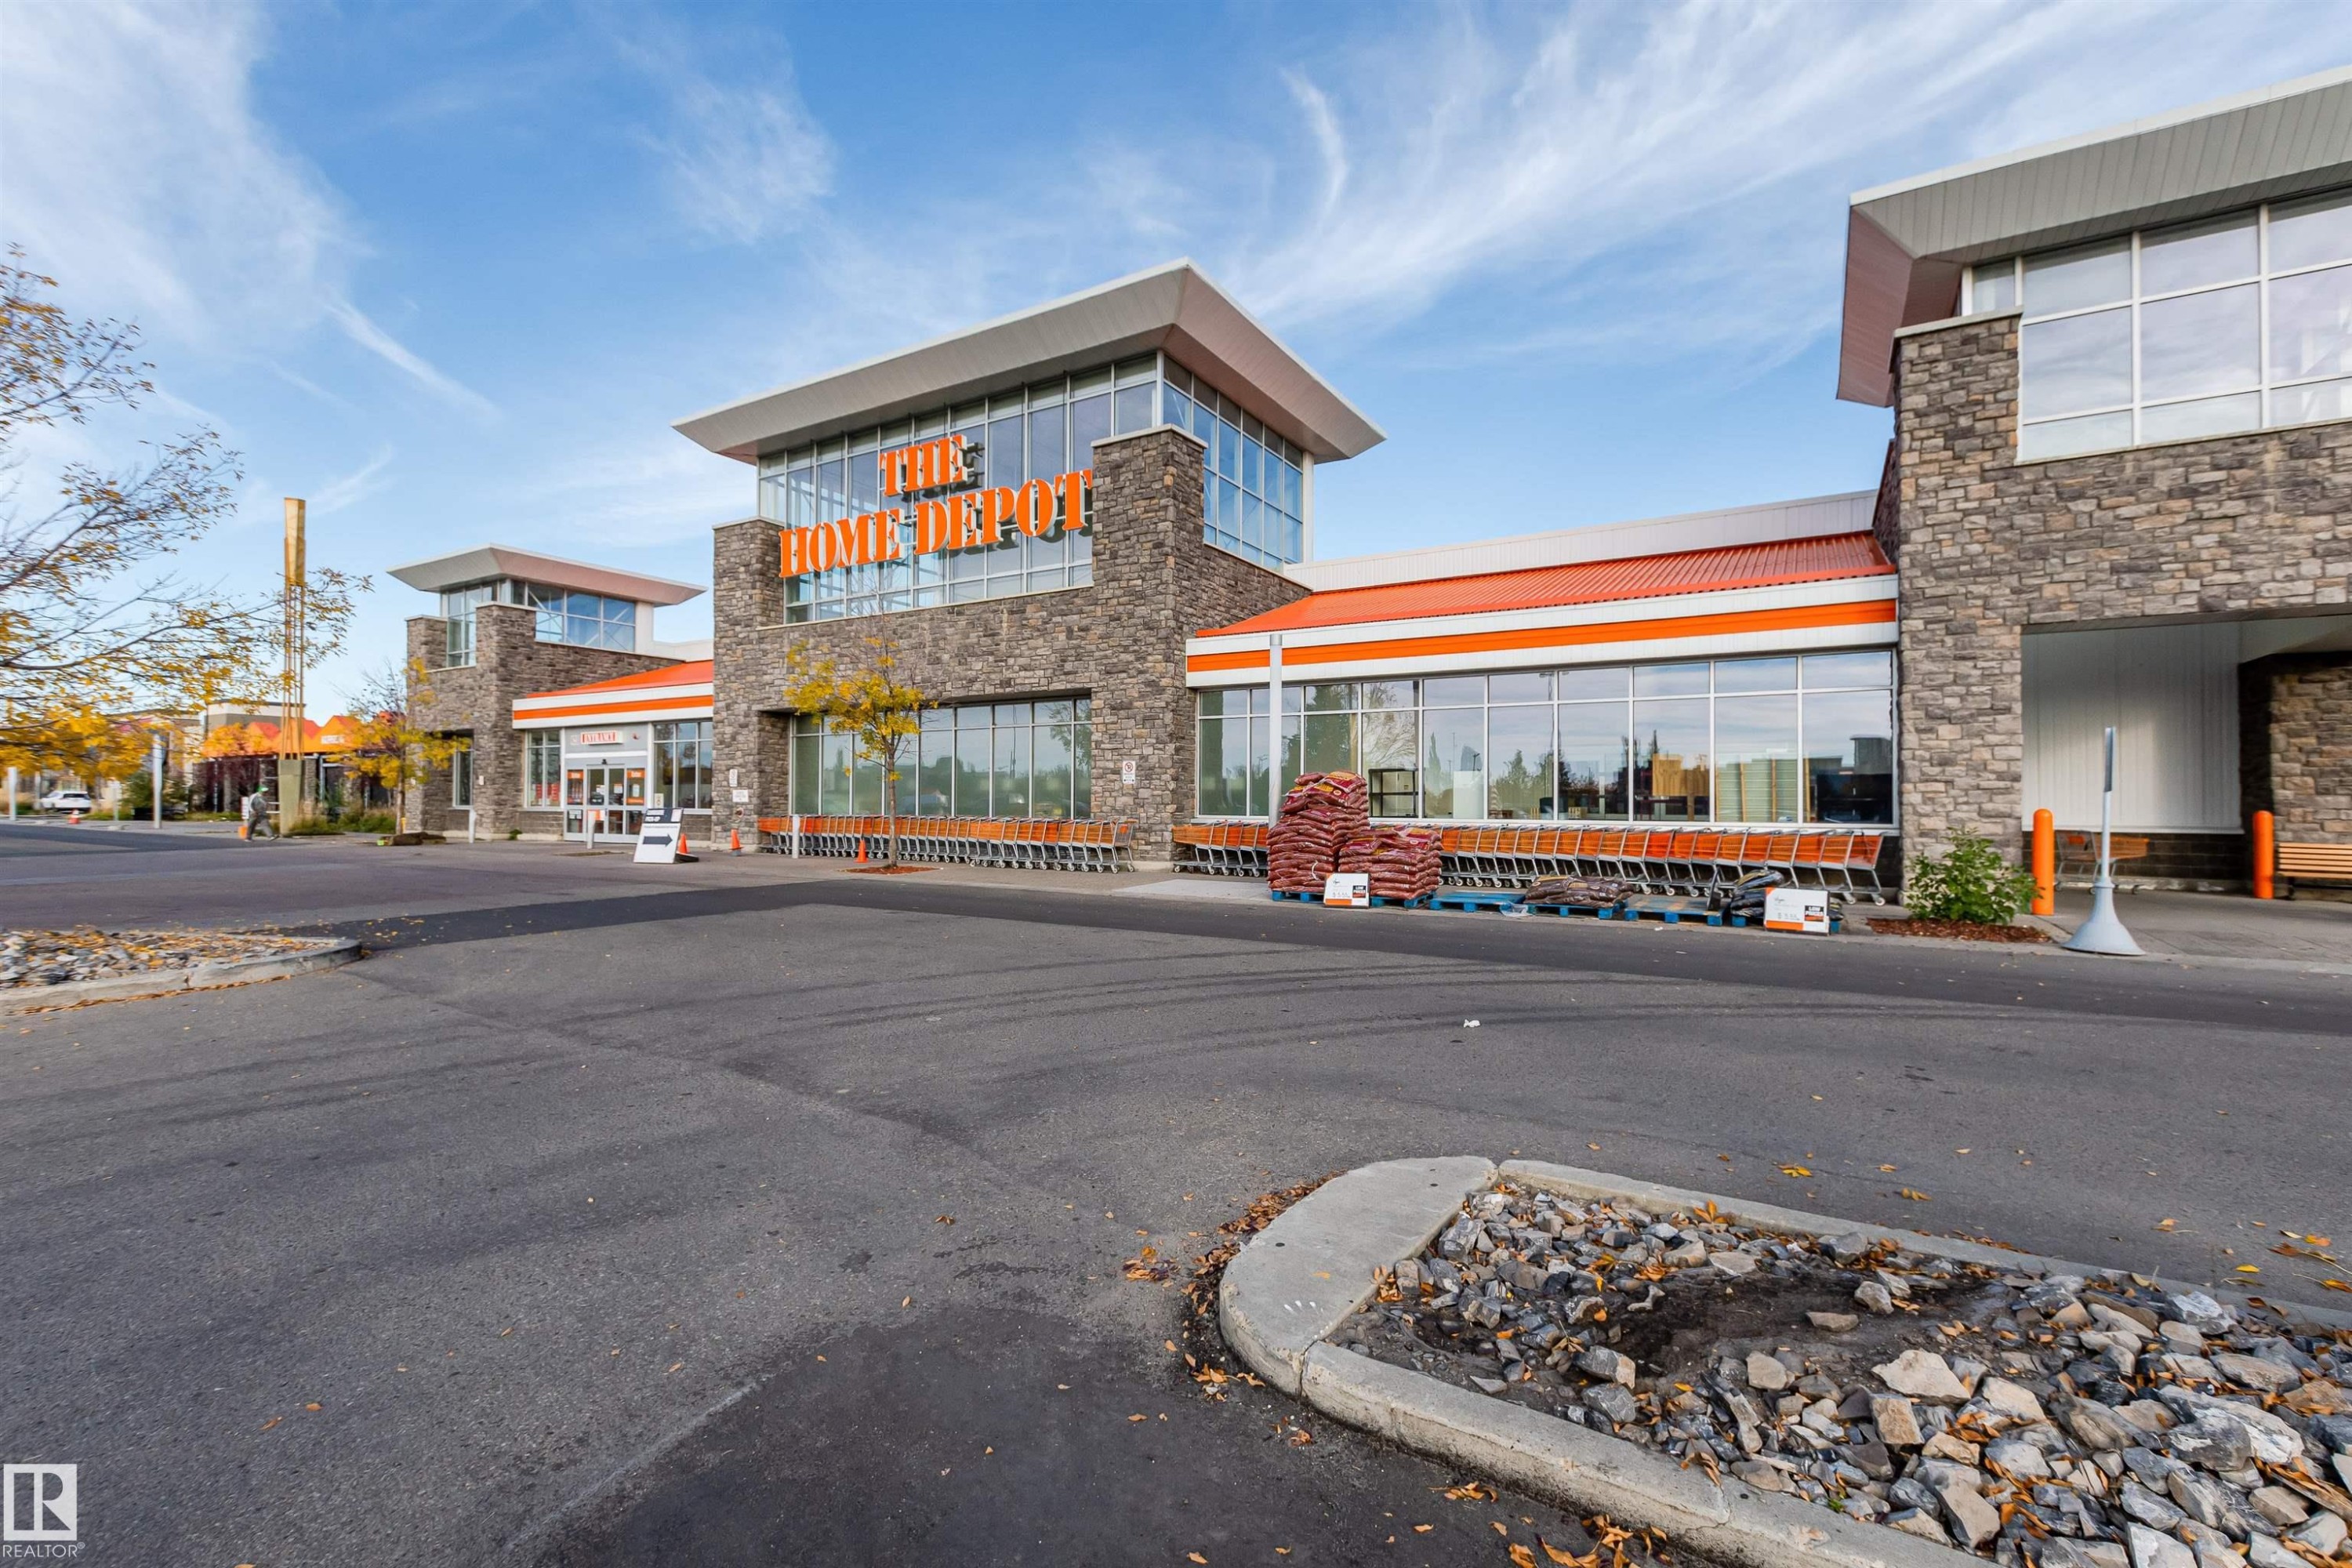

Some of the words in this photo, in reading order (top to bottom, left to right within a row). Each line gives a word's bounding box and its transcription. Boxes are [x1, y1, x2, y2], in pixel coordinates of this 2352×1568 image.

[880, 434, 967, 497] THE
[779, 508, 904, 578] HOME
[914, 469, 1093, 556] DEPOT
